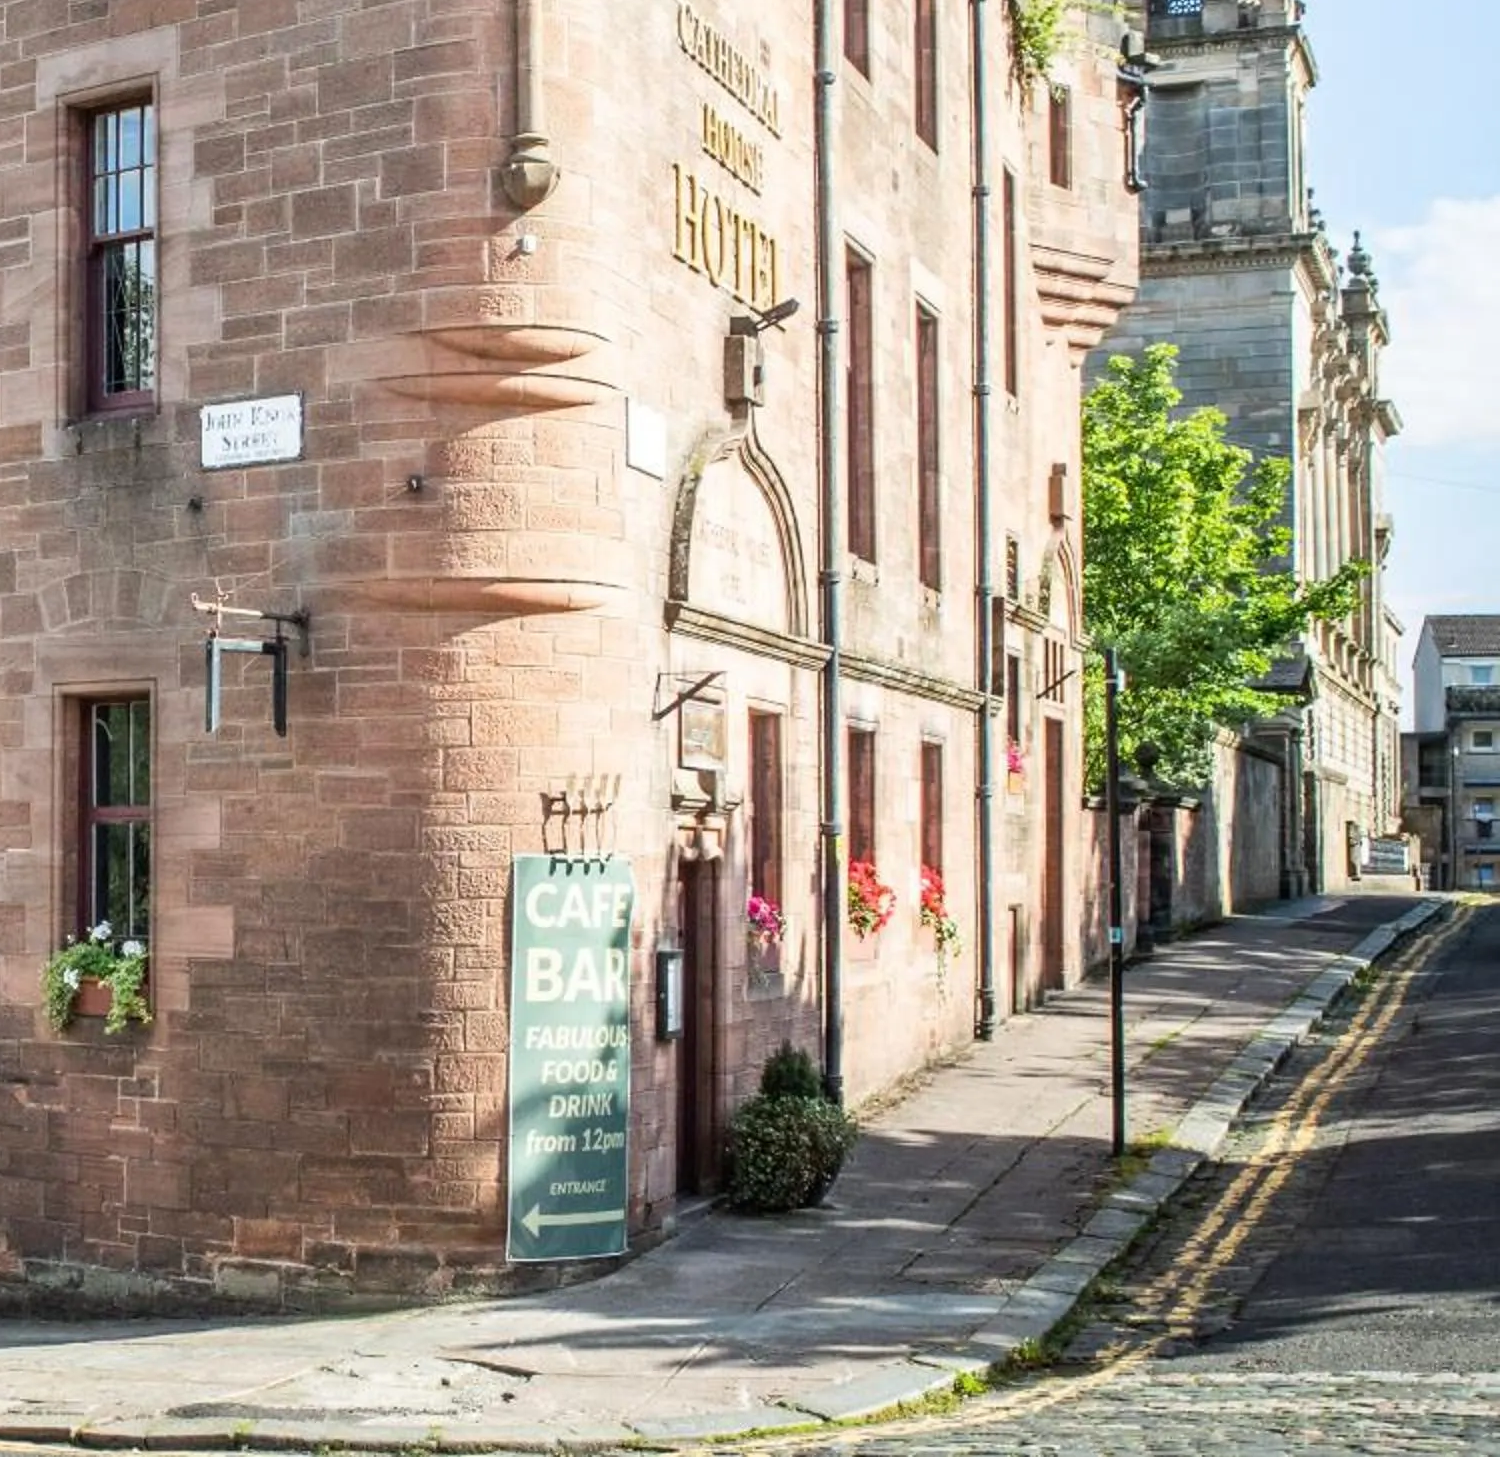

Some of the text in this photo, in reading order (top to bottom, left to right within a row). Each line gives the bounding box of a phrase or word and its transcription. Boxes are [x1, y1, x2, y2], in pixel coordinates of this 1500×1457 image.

[671, 161, 785, 325] HOTEL
[526, 882, 631, 928] CAFE
[526, 947, 626, 1002] BAR
[525, 1024, 628, 1050] FABULOUS
[541, 1058, 619, 1084] FOOD &
[548, 1093, 614, 1119] DRINK
[525, 1127, 625, 1159] from 12pm
[549, 1178, 607, 1196] ENTRANCE
